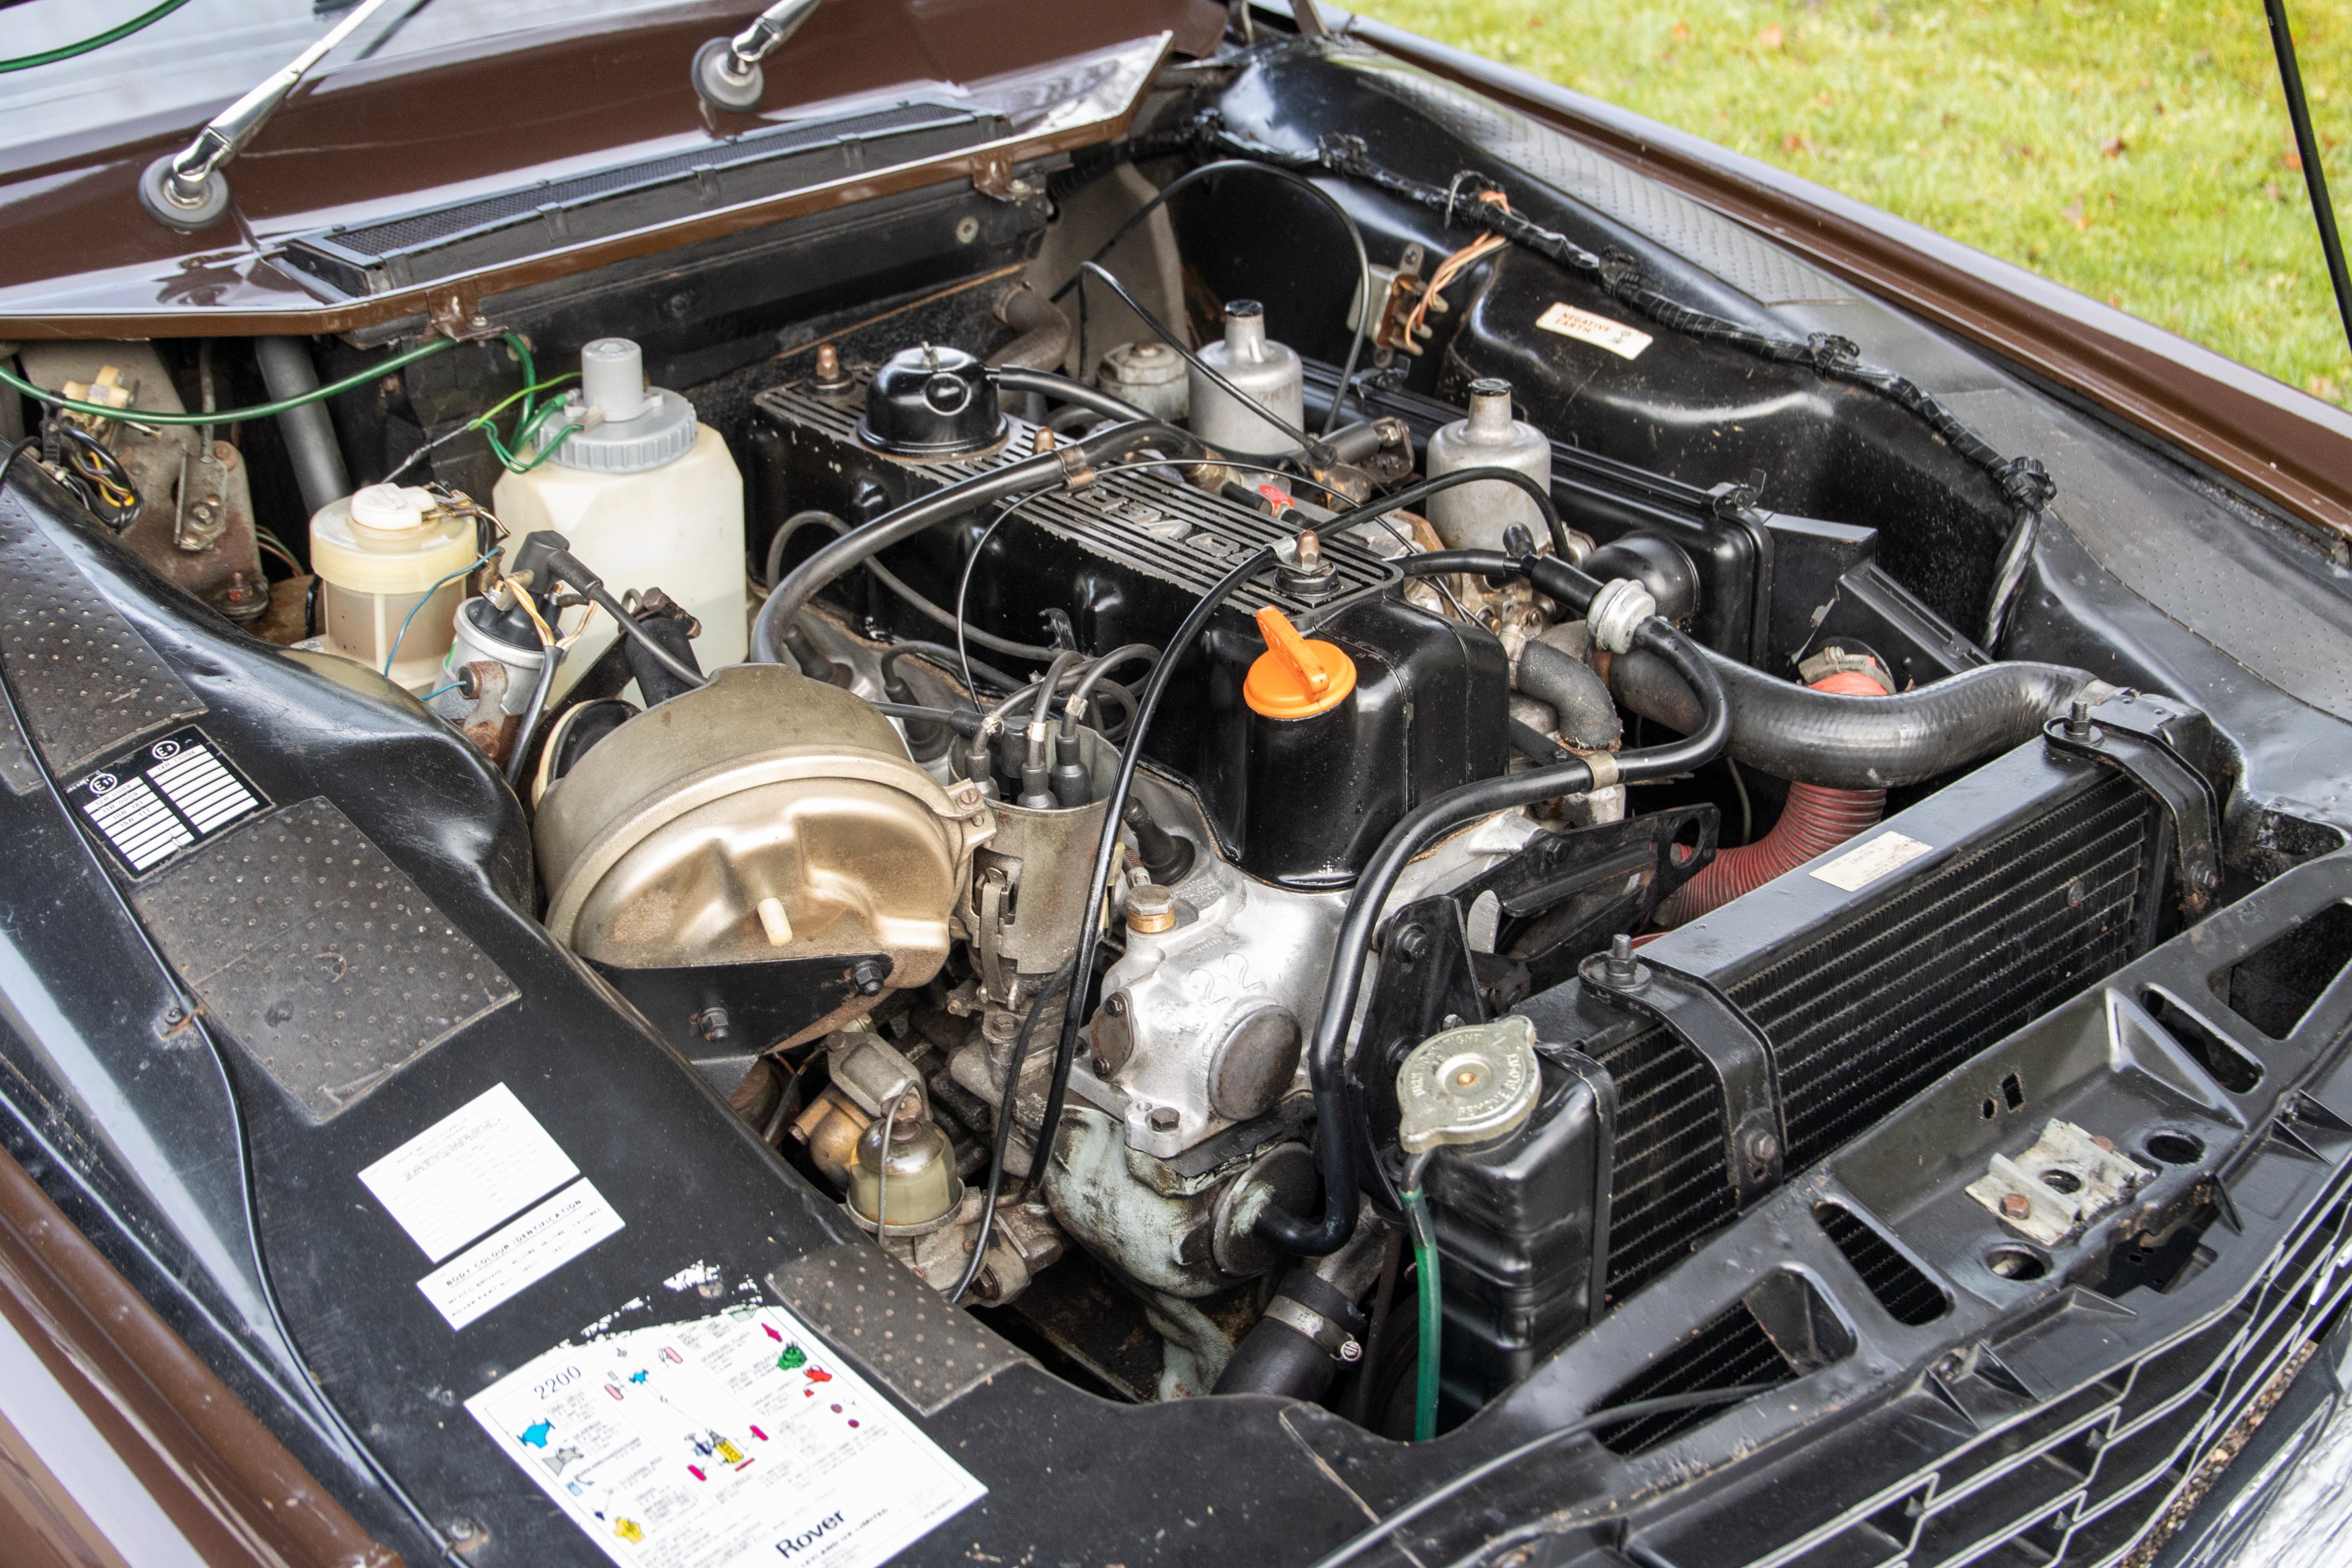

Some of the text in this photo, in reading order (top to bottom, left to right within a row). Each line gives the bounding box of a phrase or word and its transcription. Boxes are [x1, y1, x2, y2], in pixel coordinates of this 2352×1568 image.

[1556, 318, 1591, 333] EARTH
[1561, 313, 1610, 332] NEGATIVE
[1458, 1090, 1511, 1117] REMOVE
[446, 1268, 470, 1287] BODY
[474, 1244, 509, 1268] COLOUR
[513, 1199, 582, 1244] IDENTIFICATION
[534, 1365, 581, 1400] 2200
[775, 1510, 845, 1559] Rover
